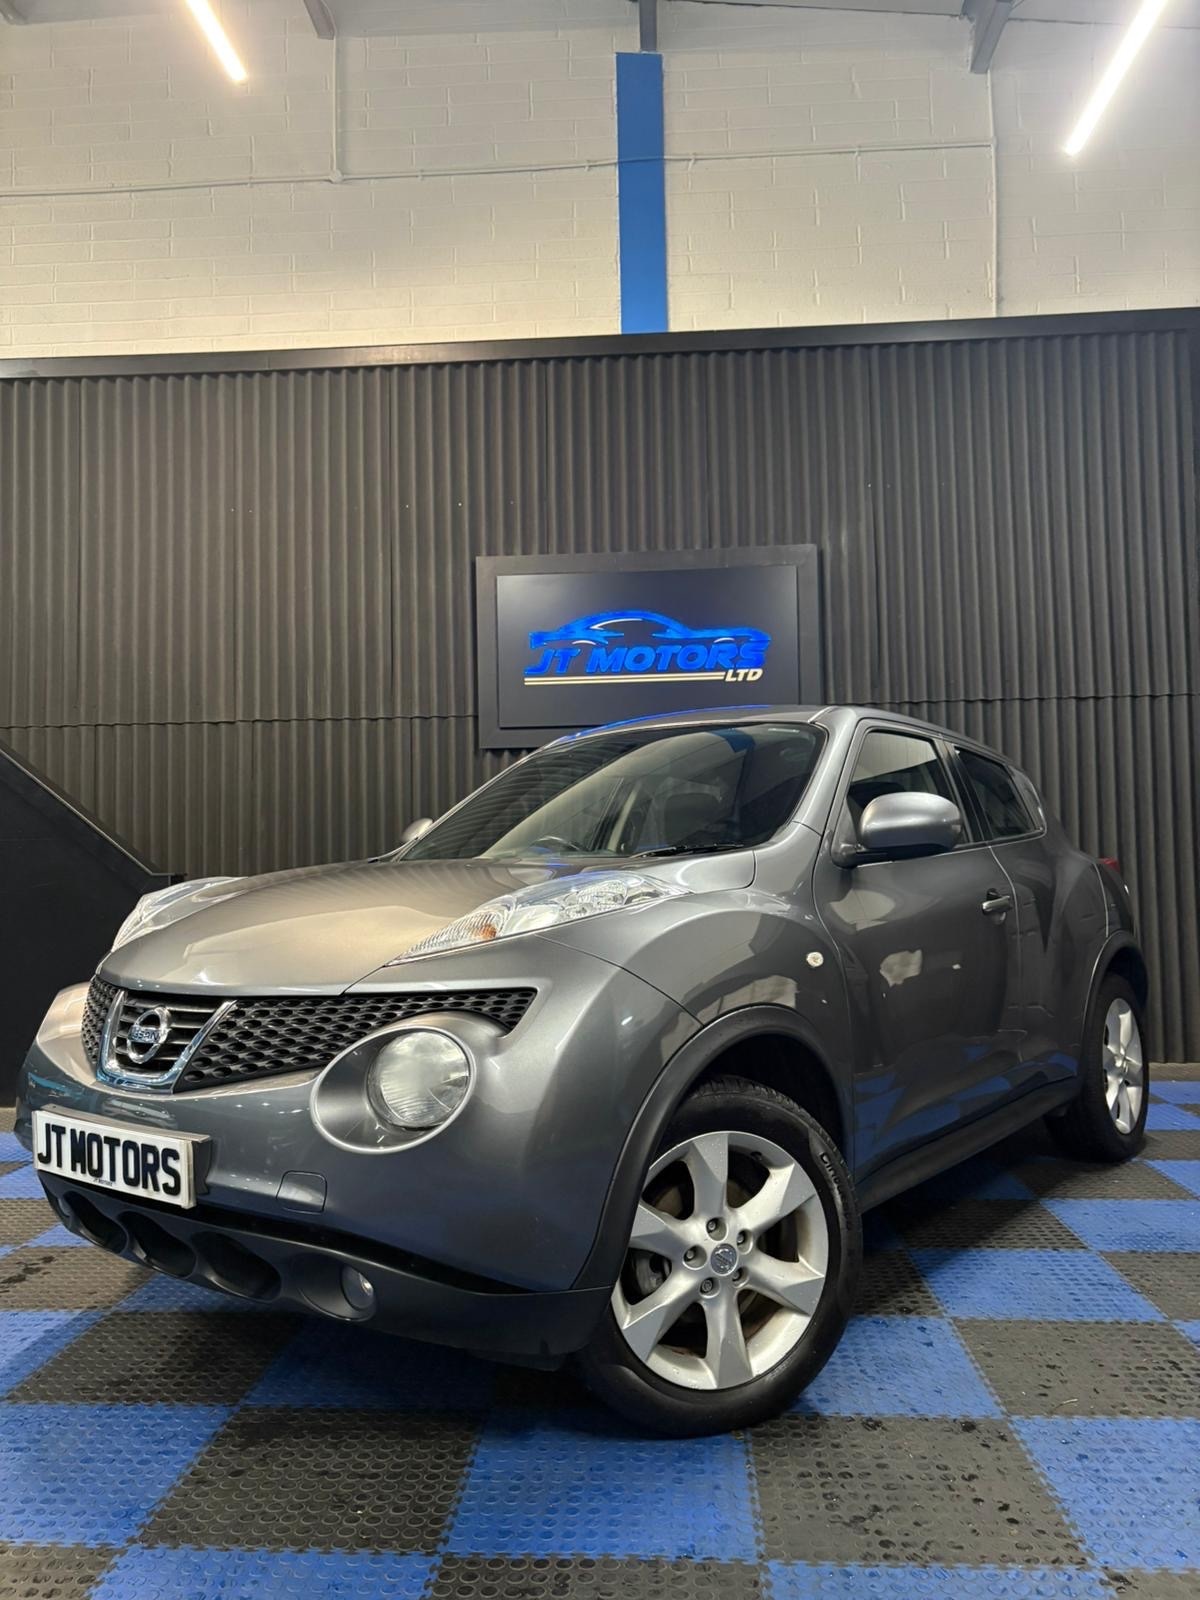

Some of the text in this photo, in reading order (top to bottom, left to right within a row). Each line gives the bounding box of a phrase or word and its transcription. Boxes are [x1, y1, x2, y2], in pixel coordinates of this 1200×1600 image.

[524, 642, 769, 675] JT MOTORS
[725, 668, 763, 682] LTD
[37, 1123, 181, 1196] JT MOTORS
